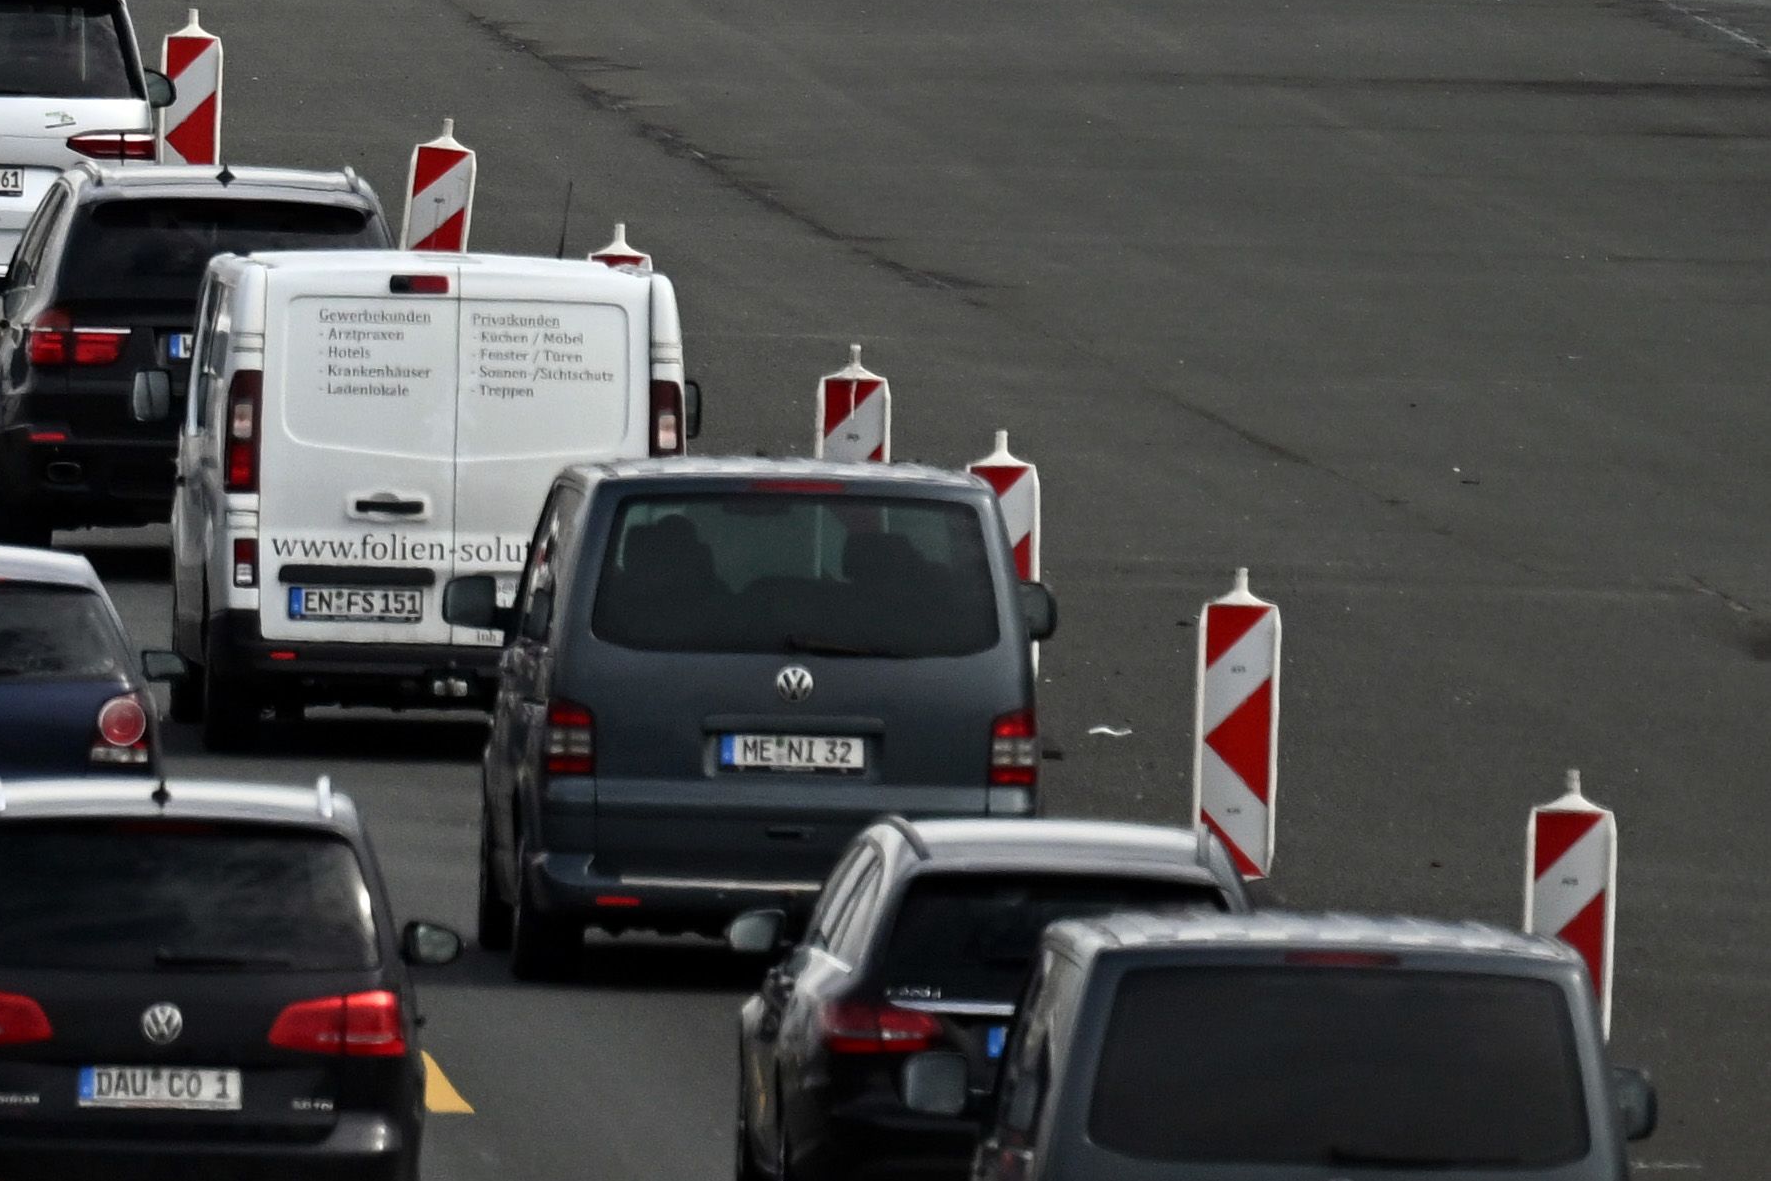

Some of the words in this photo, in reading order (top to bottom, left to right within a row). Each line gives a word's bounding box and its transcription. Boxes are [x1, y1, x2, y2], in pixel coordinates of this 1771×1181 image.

[319, 308, 431, 323] Gewerbekunden
[472, 313, 560, 328] Privatkunden
[328, 328, 405, 343] Arztpraxen
[481, 332, 528, 344] Küchen
[543, 333, 583, 345] Möbel
[328, 346, 371, 359] Hotels
[480, 348, 529, 362] Fenster
[544, 350, 583, 363] Türen
[328, 364, 431, 379] Krankenhäuser
[327, 383, 410, 397] Ladenlokale
[480, 385, 534, 399] Treppen
[380, 594, 419, 615] 151
[825, 741, 852, 763] 32
